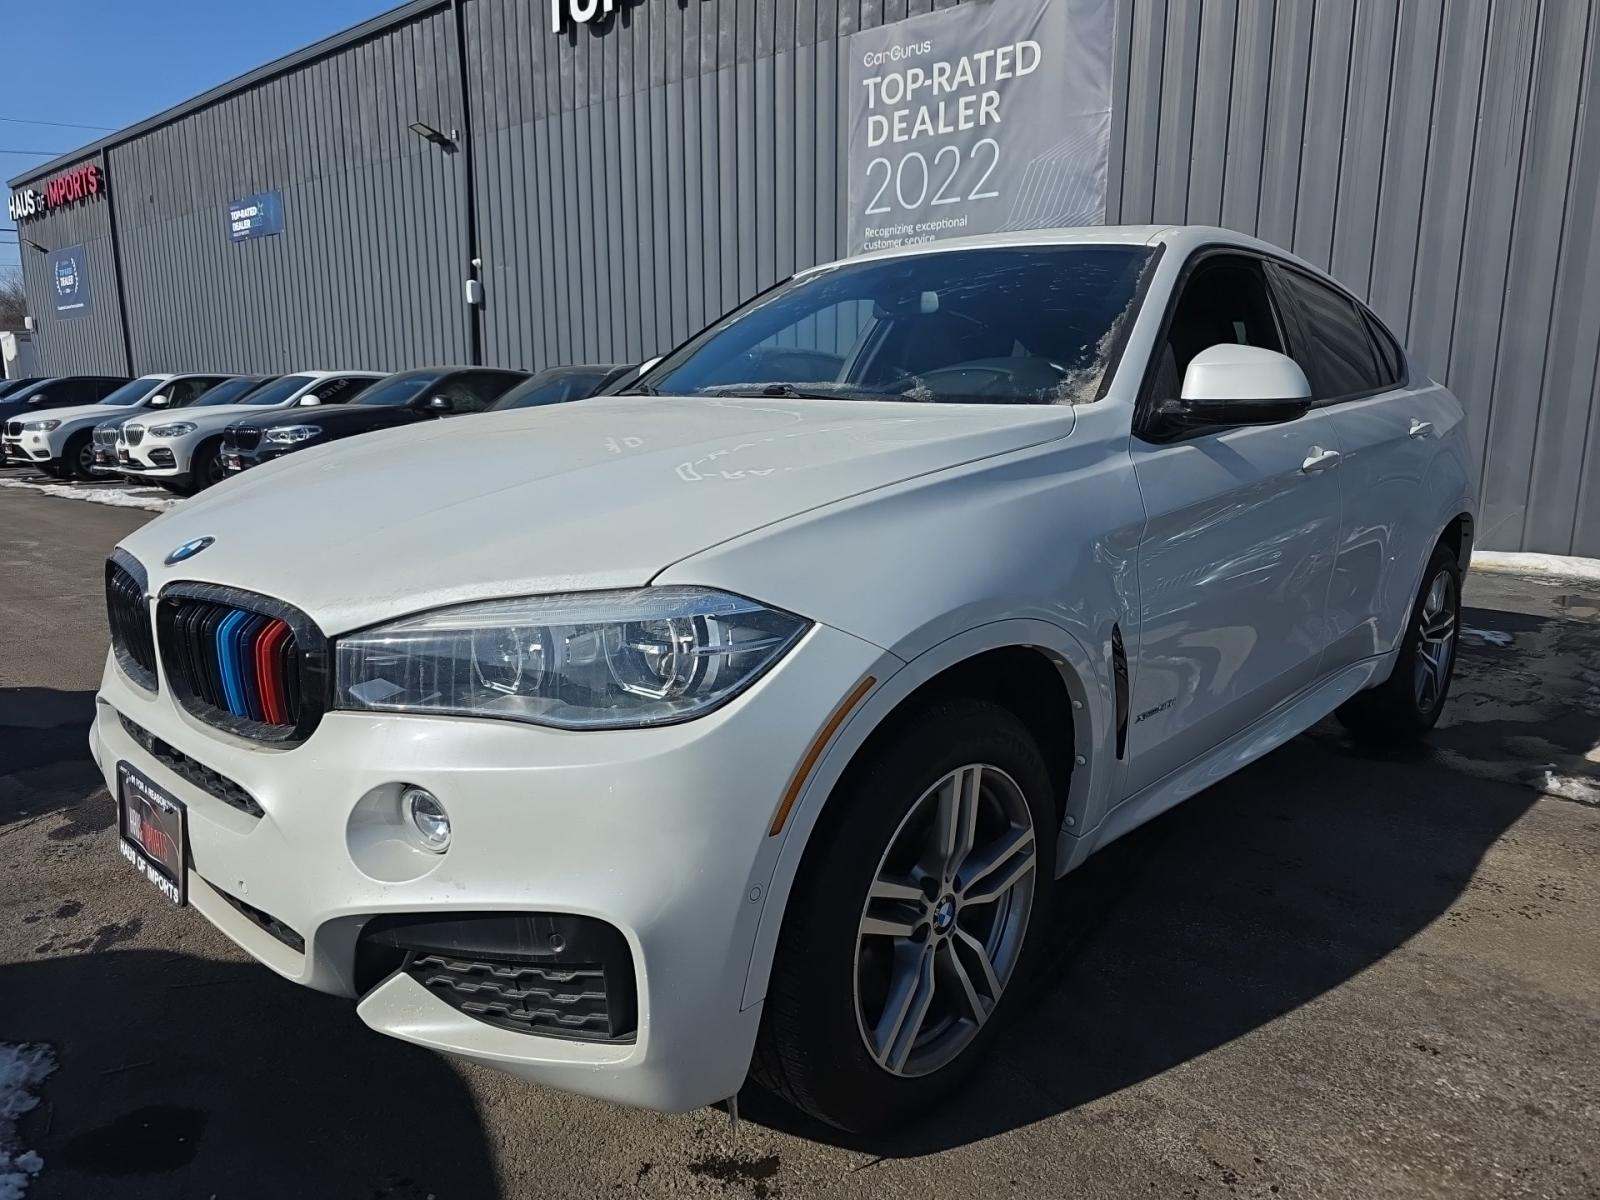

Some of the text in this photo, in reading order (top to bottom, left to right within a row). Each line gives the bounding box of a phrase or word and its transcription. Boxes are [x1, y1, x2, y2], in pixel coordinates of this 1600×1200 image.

[863, 40, 932, 67] CarGurus
[863, 40, 1041, 109] TOP-RATED
[867, 90, 1001, 148] DEALER
[8, 165, 97, 220] HAUS OF IMPORTS
[865, 138, 1000, 215] 2022
[863, 234, 936, 251] customer service
[864, 215, 968, 239] Recognizing exceptional
[137, 856, 146, 873] OF
[147, 863, 179, 904] IMPORTS
